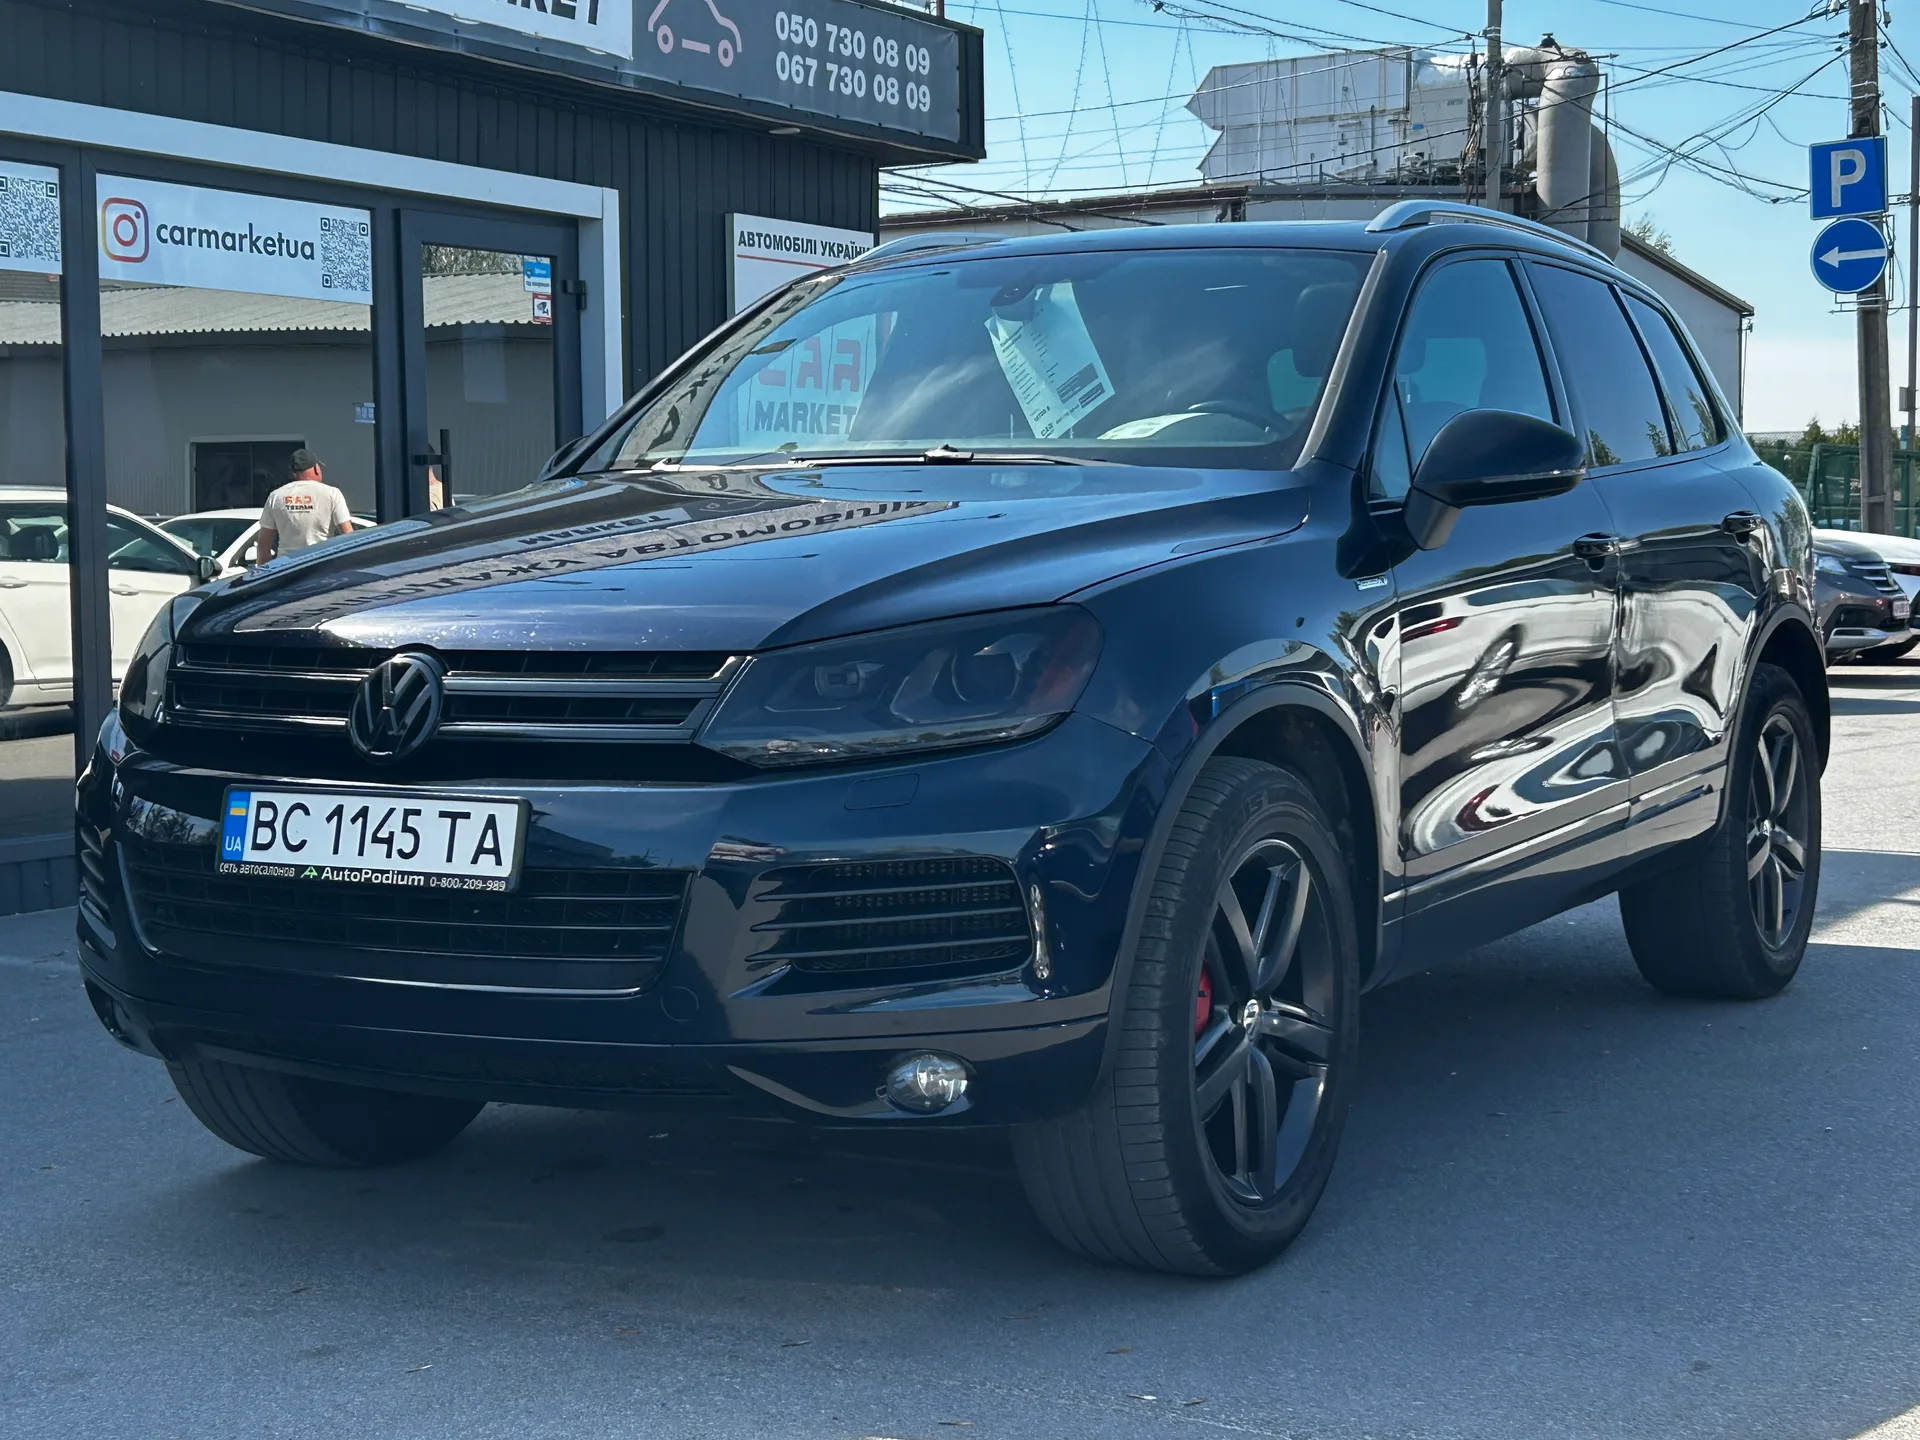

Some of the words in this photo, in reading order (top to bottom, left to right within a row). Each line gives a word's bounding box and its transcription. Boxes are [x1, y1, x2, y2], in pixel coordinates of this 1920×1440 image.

[775, 11, 818, 48] 050
[825, 23, 866, 60] 730
[873, 36, 899, 68] 08
[905, 44, 930, 76] 09
[776, 51, 818, 87] 067
[826, 62, 867, 98] 730
[873, 74, 900, 105] 08
[905, 81, 931, 112] 09
[1830, 148, 1867, 208] P
[156, 222, 315, 260] carmarketua
[738, 230, 817, 255] АВТОМОБІЛІ
[820, 240, 871, 260] УКРАЇН
[754, 400, 858, 435] MARKET
[225, 835, 242, 852] UA
[250, 800, 311, 853] BC
[325, 803, 422, 860] 1145
[438, 810, 503, 867] TA
[239, 863, 295, 877] автосалонов
[321, 866, 425, 887] AutoPodium
